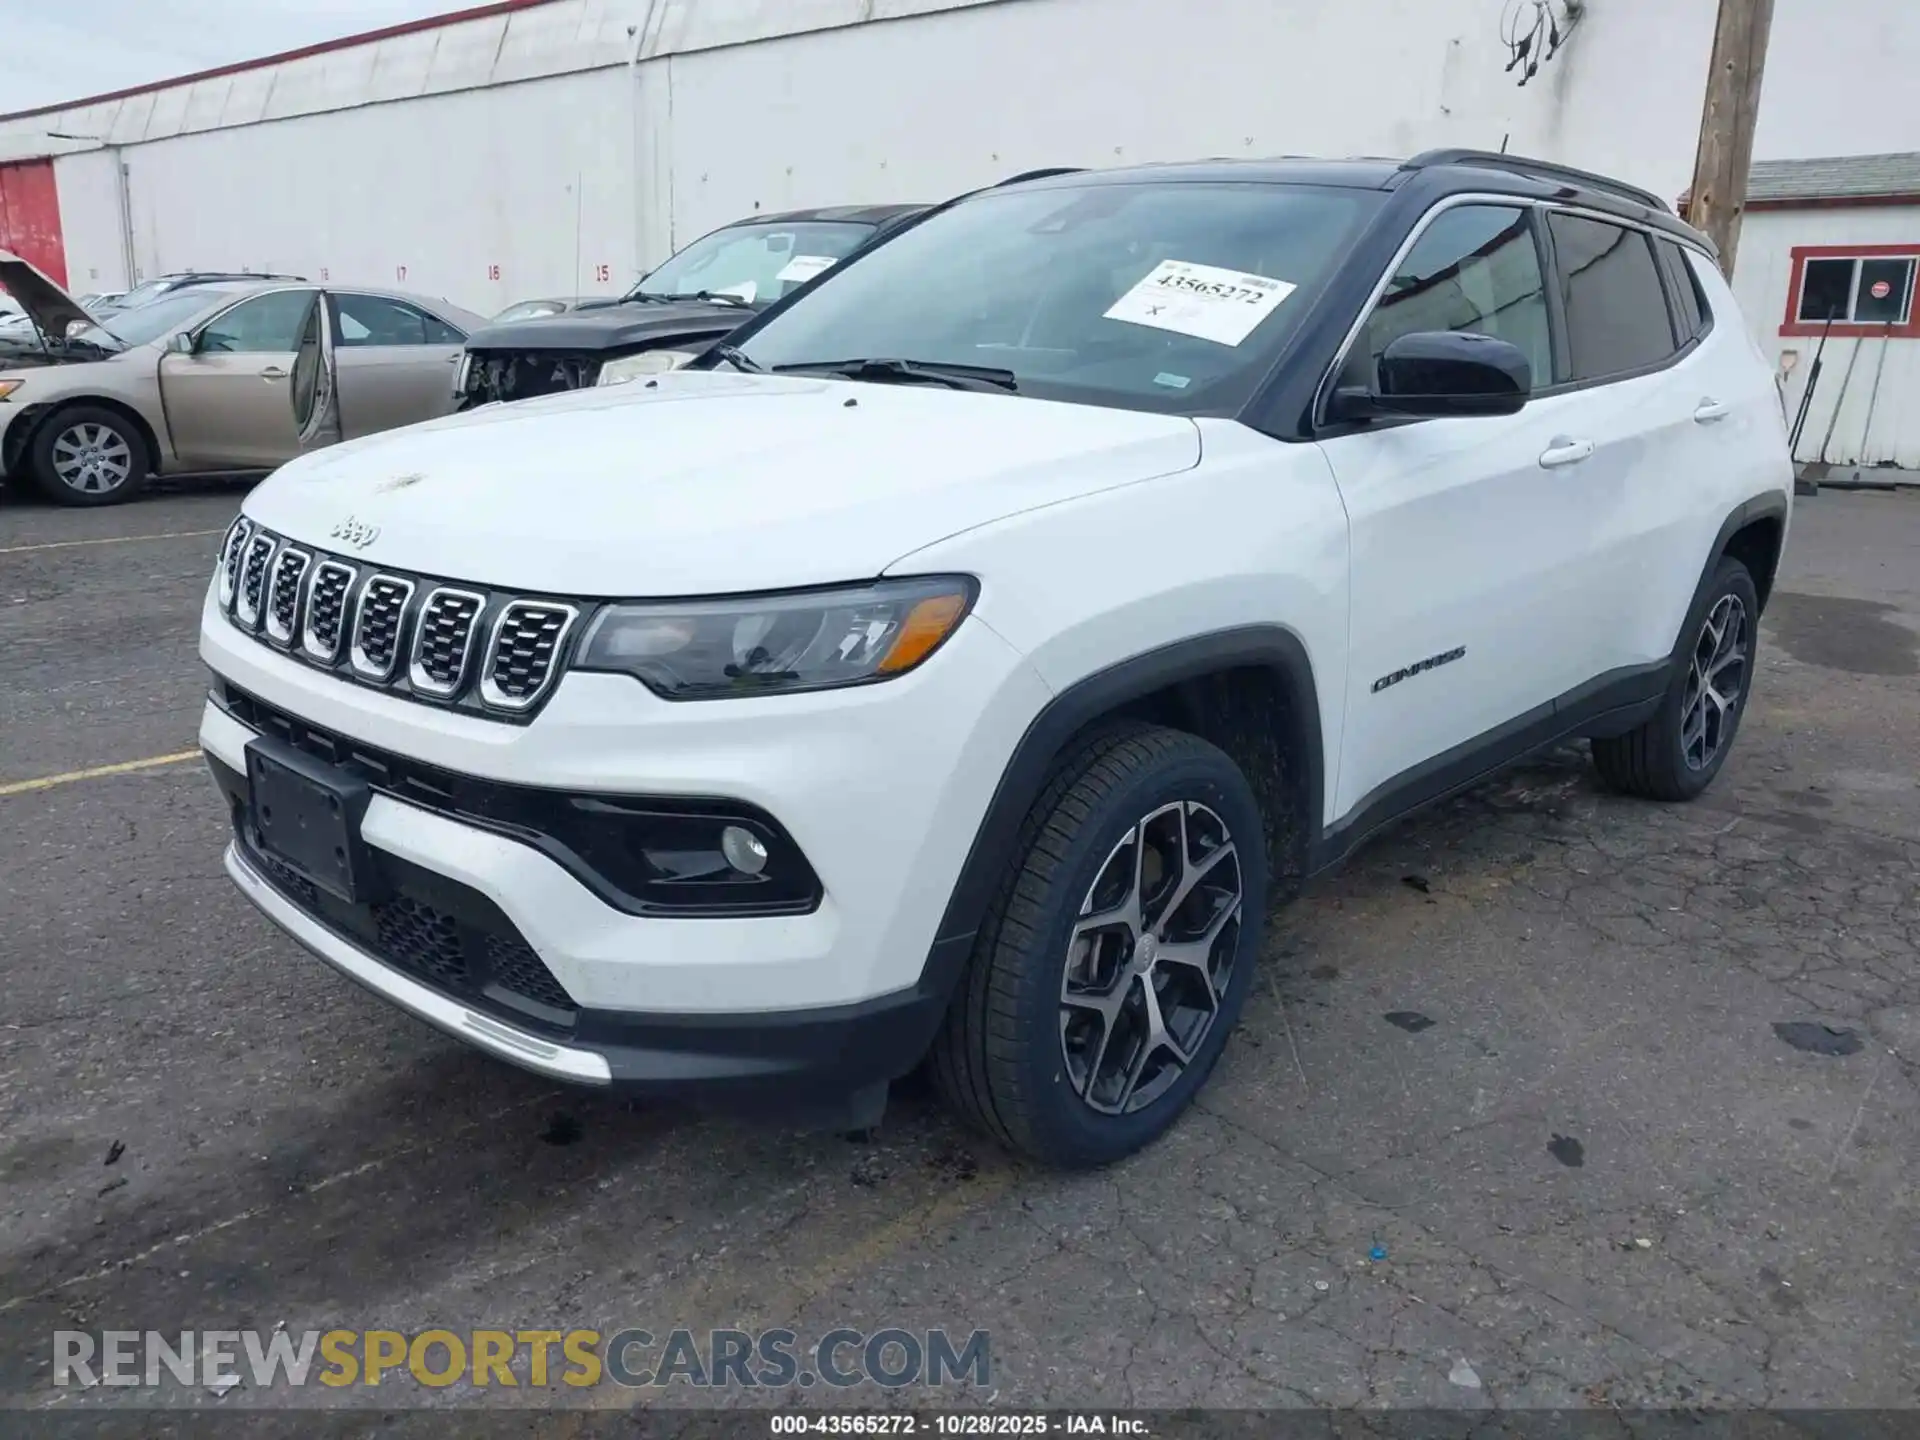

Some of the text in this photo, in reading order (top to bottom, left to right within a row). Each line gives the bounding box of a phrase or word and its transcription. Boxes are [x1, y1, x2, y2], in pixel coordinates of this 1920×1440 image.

[396, 266, 407, 281] 17
[488, 265, 500, 280] 16
[596, 265, 609, 281] 15
[1157, 274, 1264, 304] 43565272
[330, 515, 381, 550] Jeep
